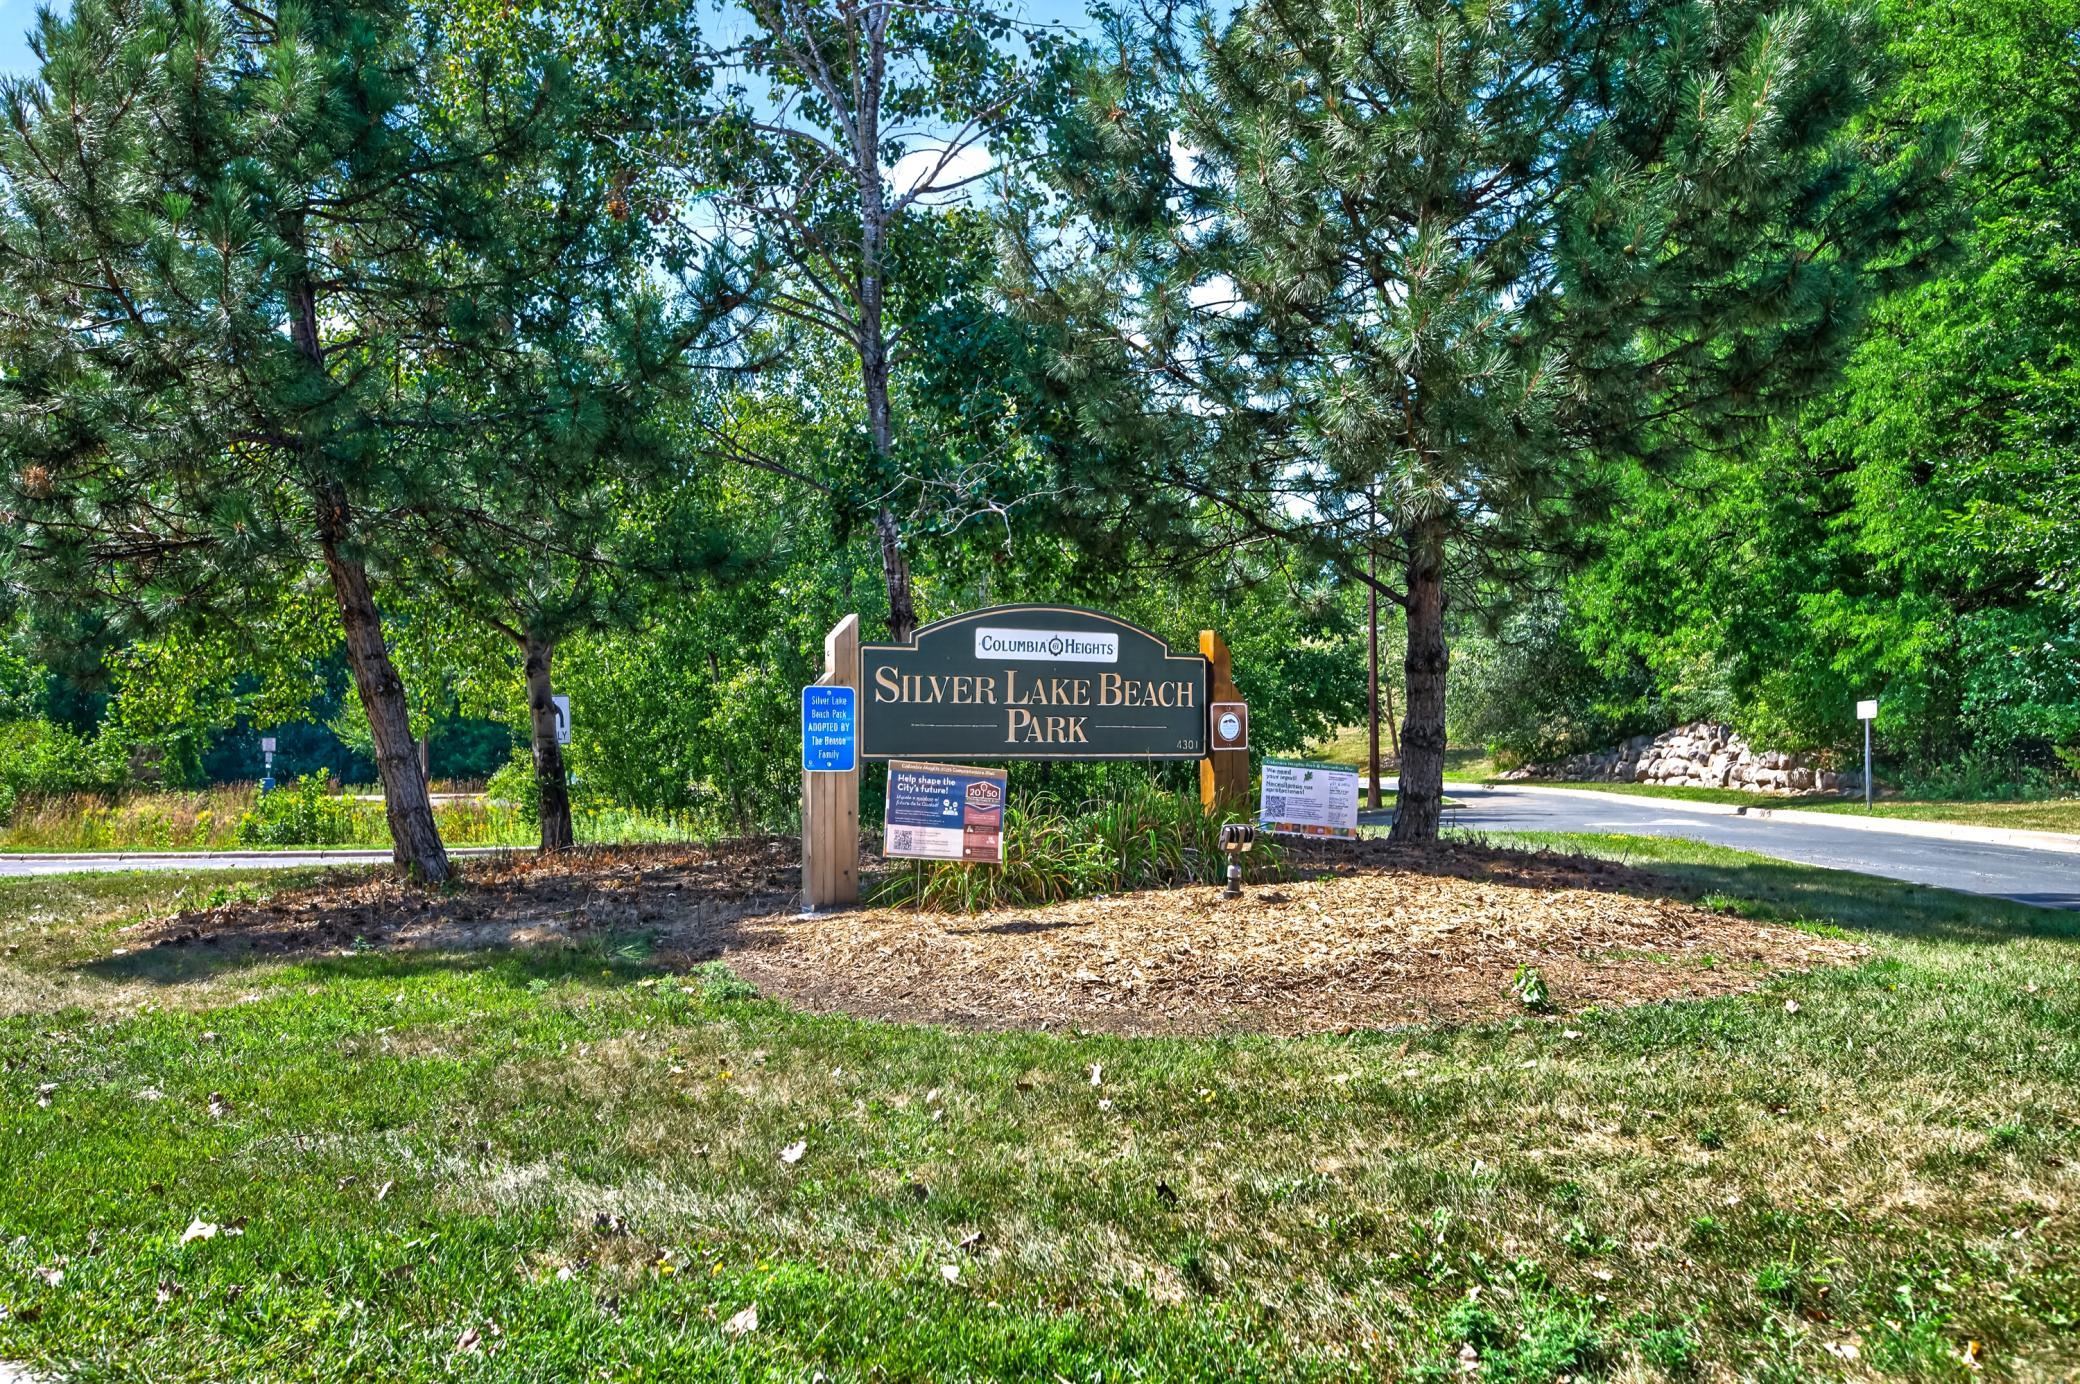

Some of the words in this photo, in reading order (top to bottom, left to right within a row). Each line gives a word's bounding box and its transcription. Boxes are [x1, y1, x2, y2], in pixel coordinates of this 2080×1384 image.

[982, 636, 1046, 653] COLUMBIA
[1065, 638, 1114, 654] HEIGHTS
[875, 666, 998, 705] SILVER
[1003, 670, 1091, 706] LAKE
[1097, 672, 1195, 708] BEACH
[812, 696, 830, 705] Silver
[832, 696, 847, 705] Lake
[812, 709, 830, 718] Beach
[832, 710, 847, 719] Park
[808, 722, 838, 732] ADOPTED
[840, 722, 850, 732] BY
[1004, 708, 1088, 744] PARK
[812, 736, 823, 745] The
[818, 750, 839, 760] Family
[898, 774, 916, 784] Help
[919, 775, 941, 785] shape
[944, 777, 956, 786] the
[898, 783, 919, 793] City's
[920, 784, 948, 794] future!
